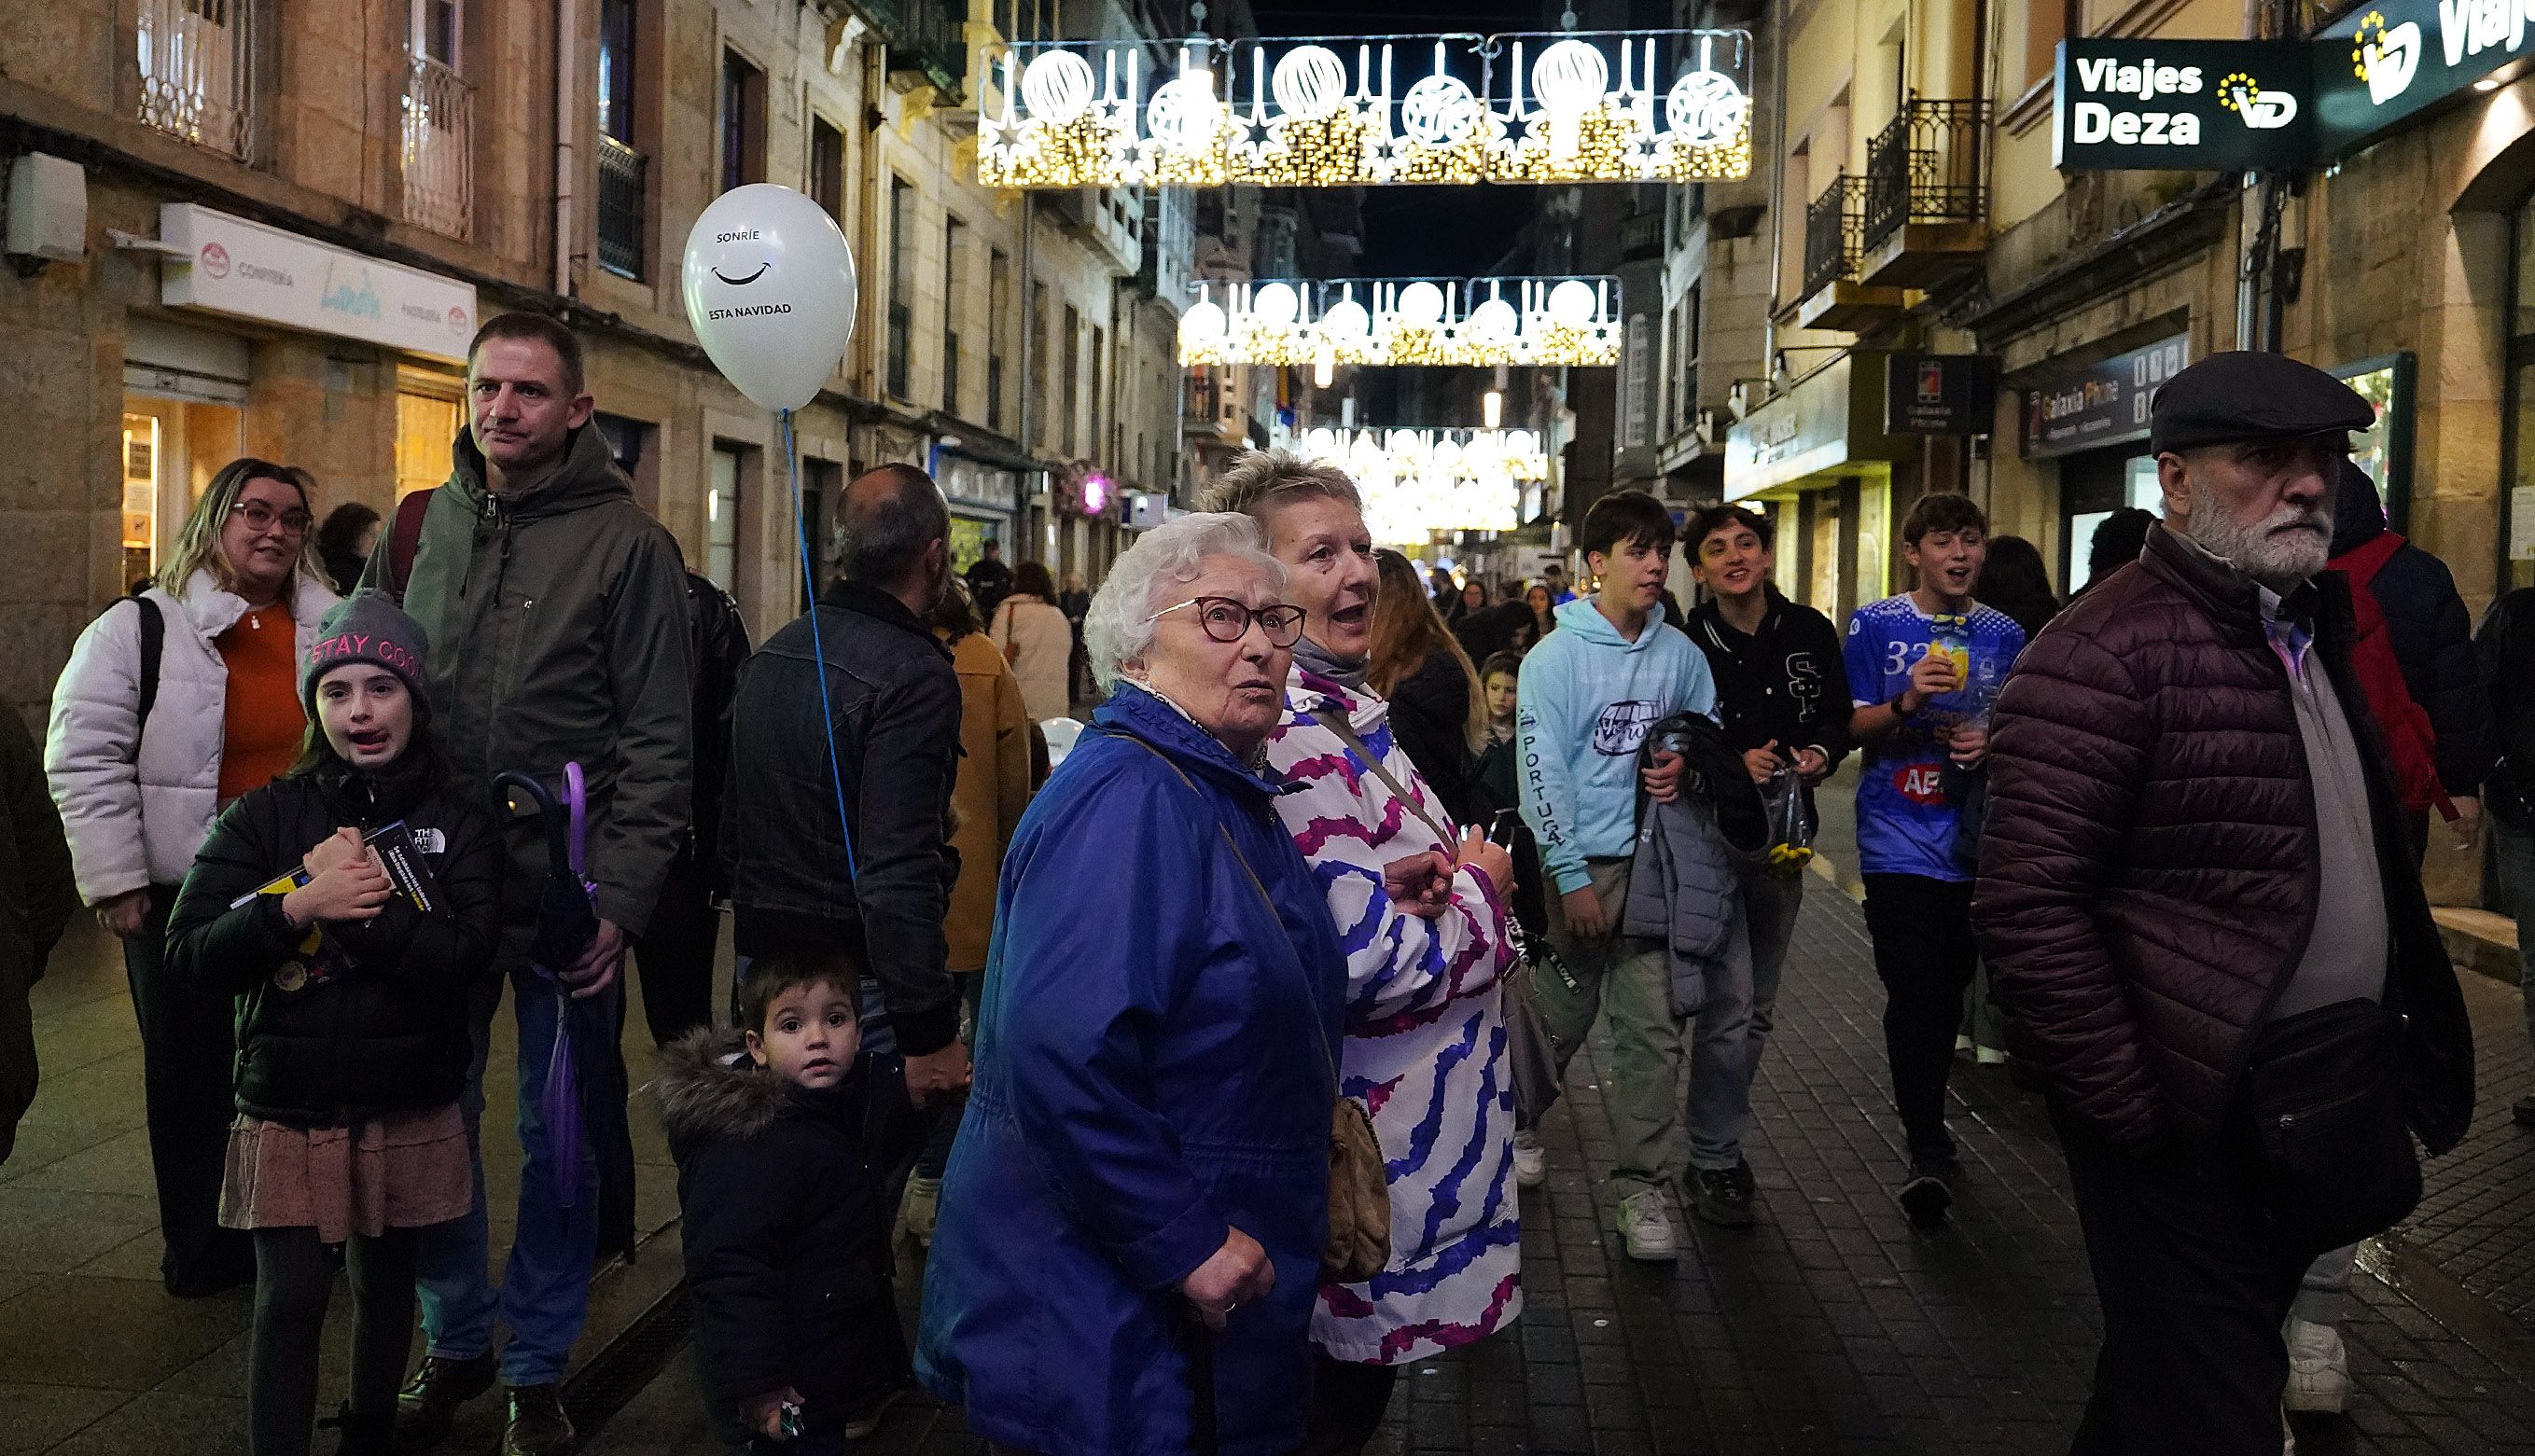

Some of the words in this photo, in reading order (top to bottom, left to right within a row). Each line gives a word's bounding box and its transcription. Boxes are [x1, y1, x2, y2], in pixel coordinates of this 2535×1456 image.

[2438, 0, 2535, 67] Viaj
[2076, 58, 2204, 101] Viajes
[2074, 102, 2200, 146] Deza
[717, 229, 760, 243] SONRÍE
[709, 310, 733, 320] ESTA
[734, 303, 792, 317] NAVIDAD
[311, 634, 370, 664] STAY
[1884, 640, 1931, 675] 32
